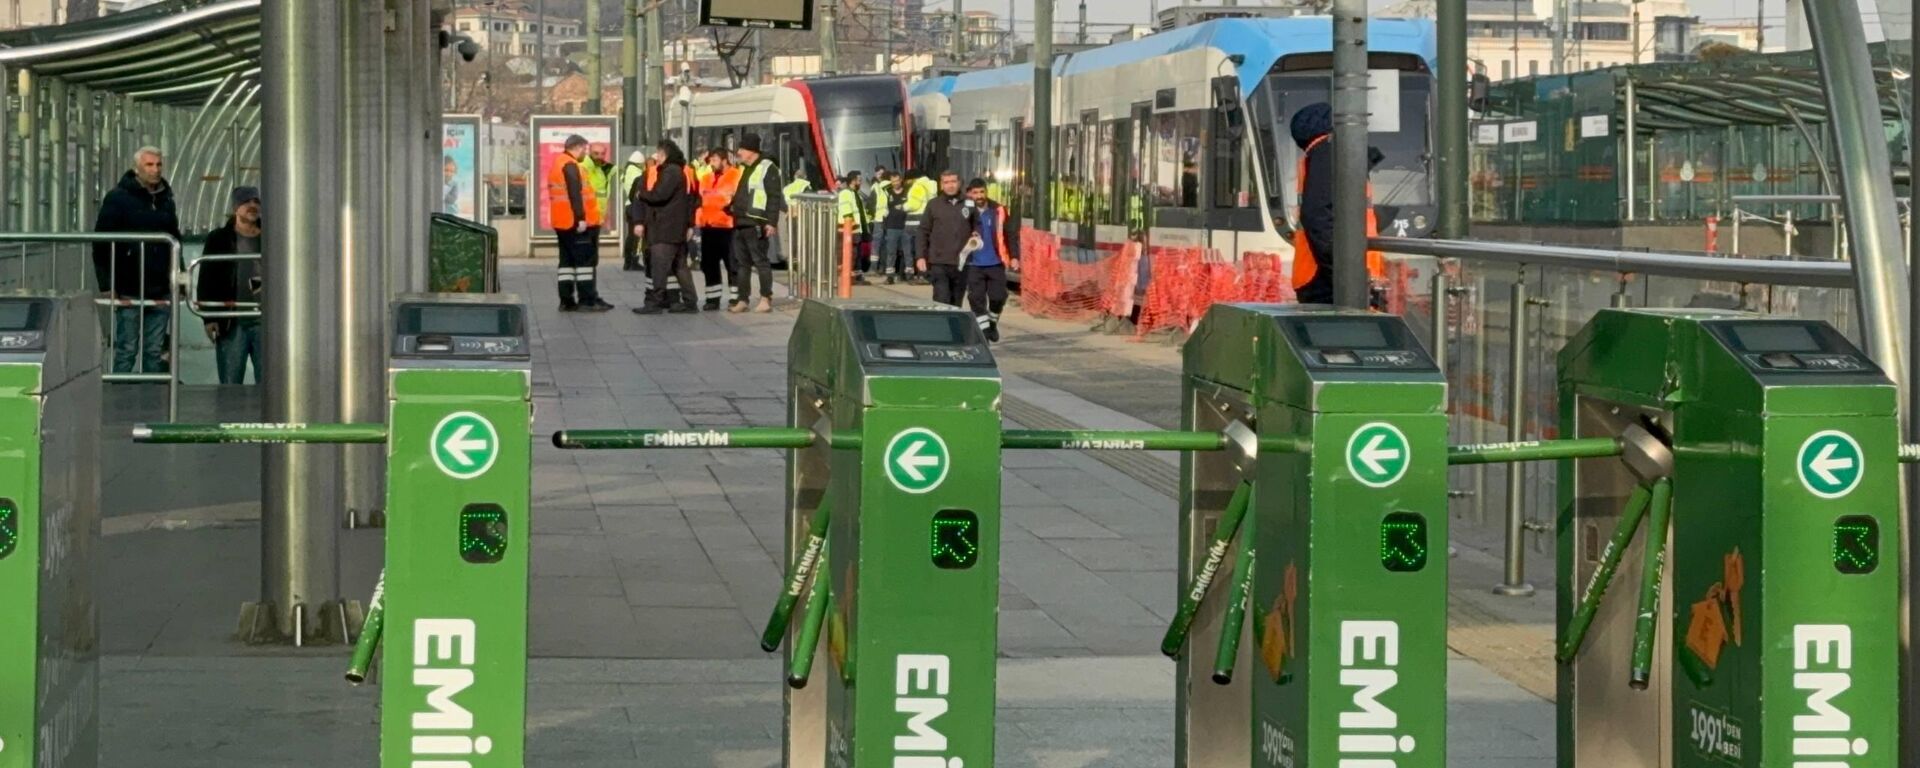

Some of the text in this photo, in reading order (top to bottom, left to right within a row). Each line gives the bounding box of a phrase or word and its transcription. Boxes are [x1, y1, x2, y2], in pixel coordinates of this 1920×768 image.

[643, 429, 729, 447] EMİNEVİM
[411, 618, 492, 768] EMİ
[1339, 620, 1416, 768] EMİ
[1793, 624, 1869, 768] EMİ
